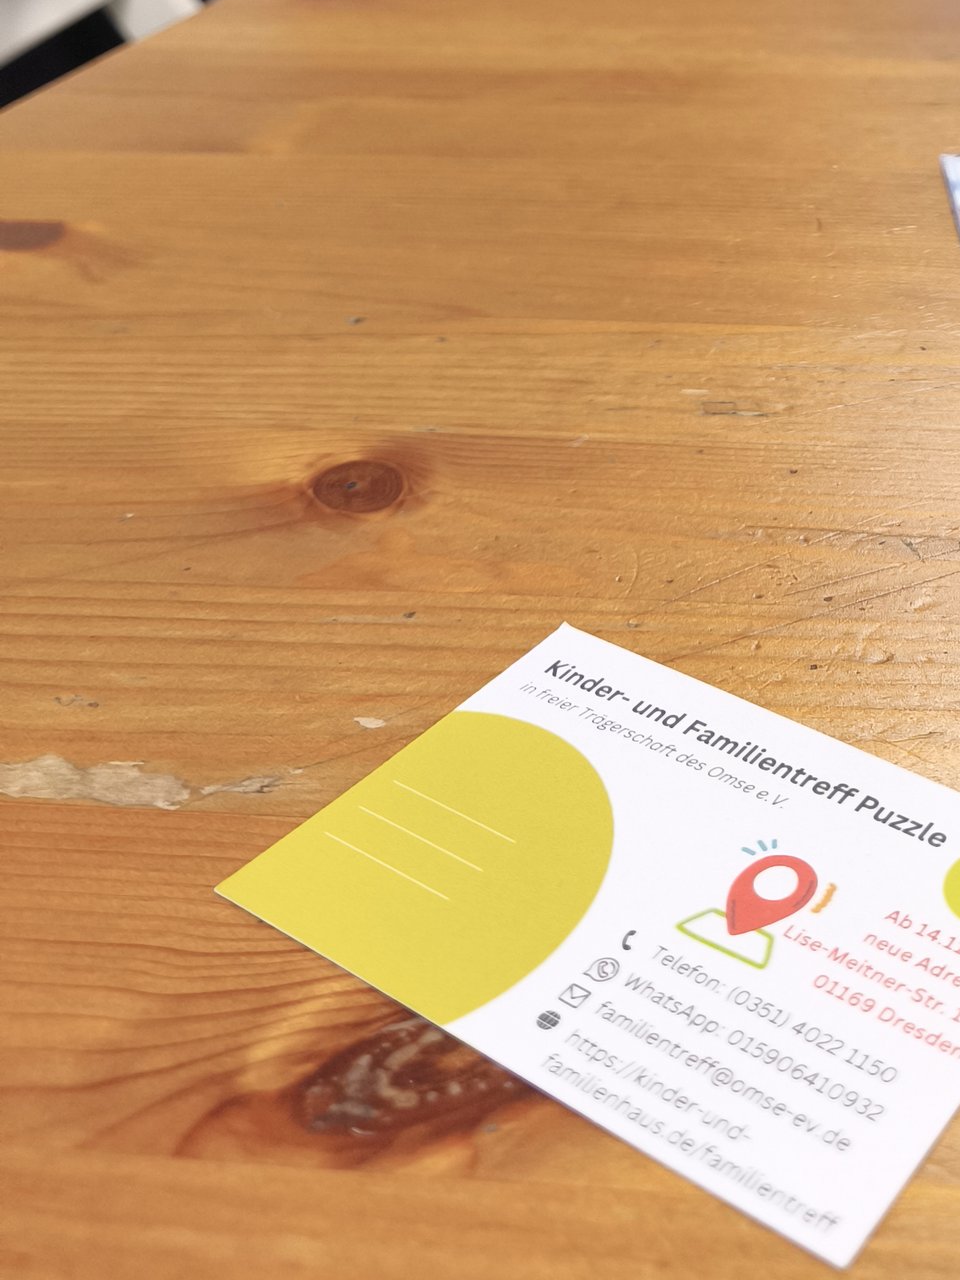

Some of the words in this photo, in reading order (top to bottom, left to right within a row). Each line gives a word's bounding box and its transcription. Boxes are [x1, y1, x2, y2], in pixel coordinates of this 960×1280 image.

[520, 681, 537, 694] in
[535, 688, 579, 712] freier
[578, 706, 678, 758] Trägerschaft
[675, 748, 707, 772] des
[707, 766, 756, 794] Omse
[755, 787, 790, 810] e.V.
[544, 660, 630, 703] Kinder-
[632, 699, 687, 729] und
[682, 719, 860, 805] Familientreff
[854, 794, 948, 848] Puzzle
[783, 924, 946, 1014] Lise-Meitner-Str.
[863, 932, 913, 963] neue
[884, 910, 913, 930] Ab
[623, 972, 727, 1036] WhatsApp:
[727, 1028, 886, 1123] 015906410932
[652, 945, 727, 994] Telefon:
[726, 985, 793, 1029] (0351)
[791, 1021, 845, 1056] 4022
[844, 1047, 898, 1084] 1150
[813, 974, 876, 1013] 01169
[594, 1002, 853, 1152] familientreff@omse-ev.de
